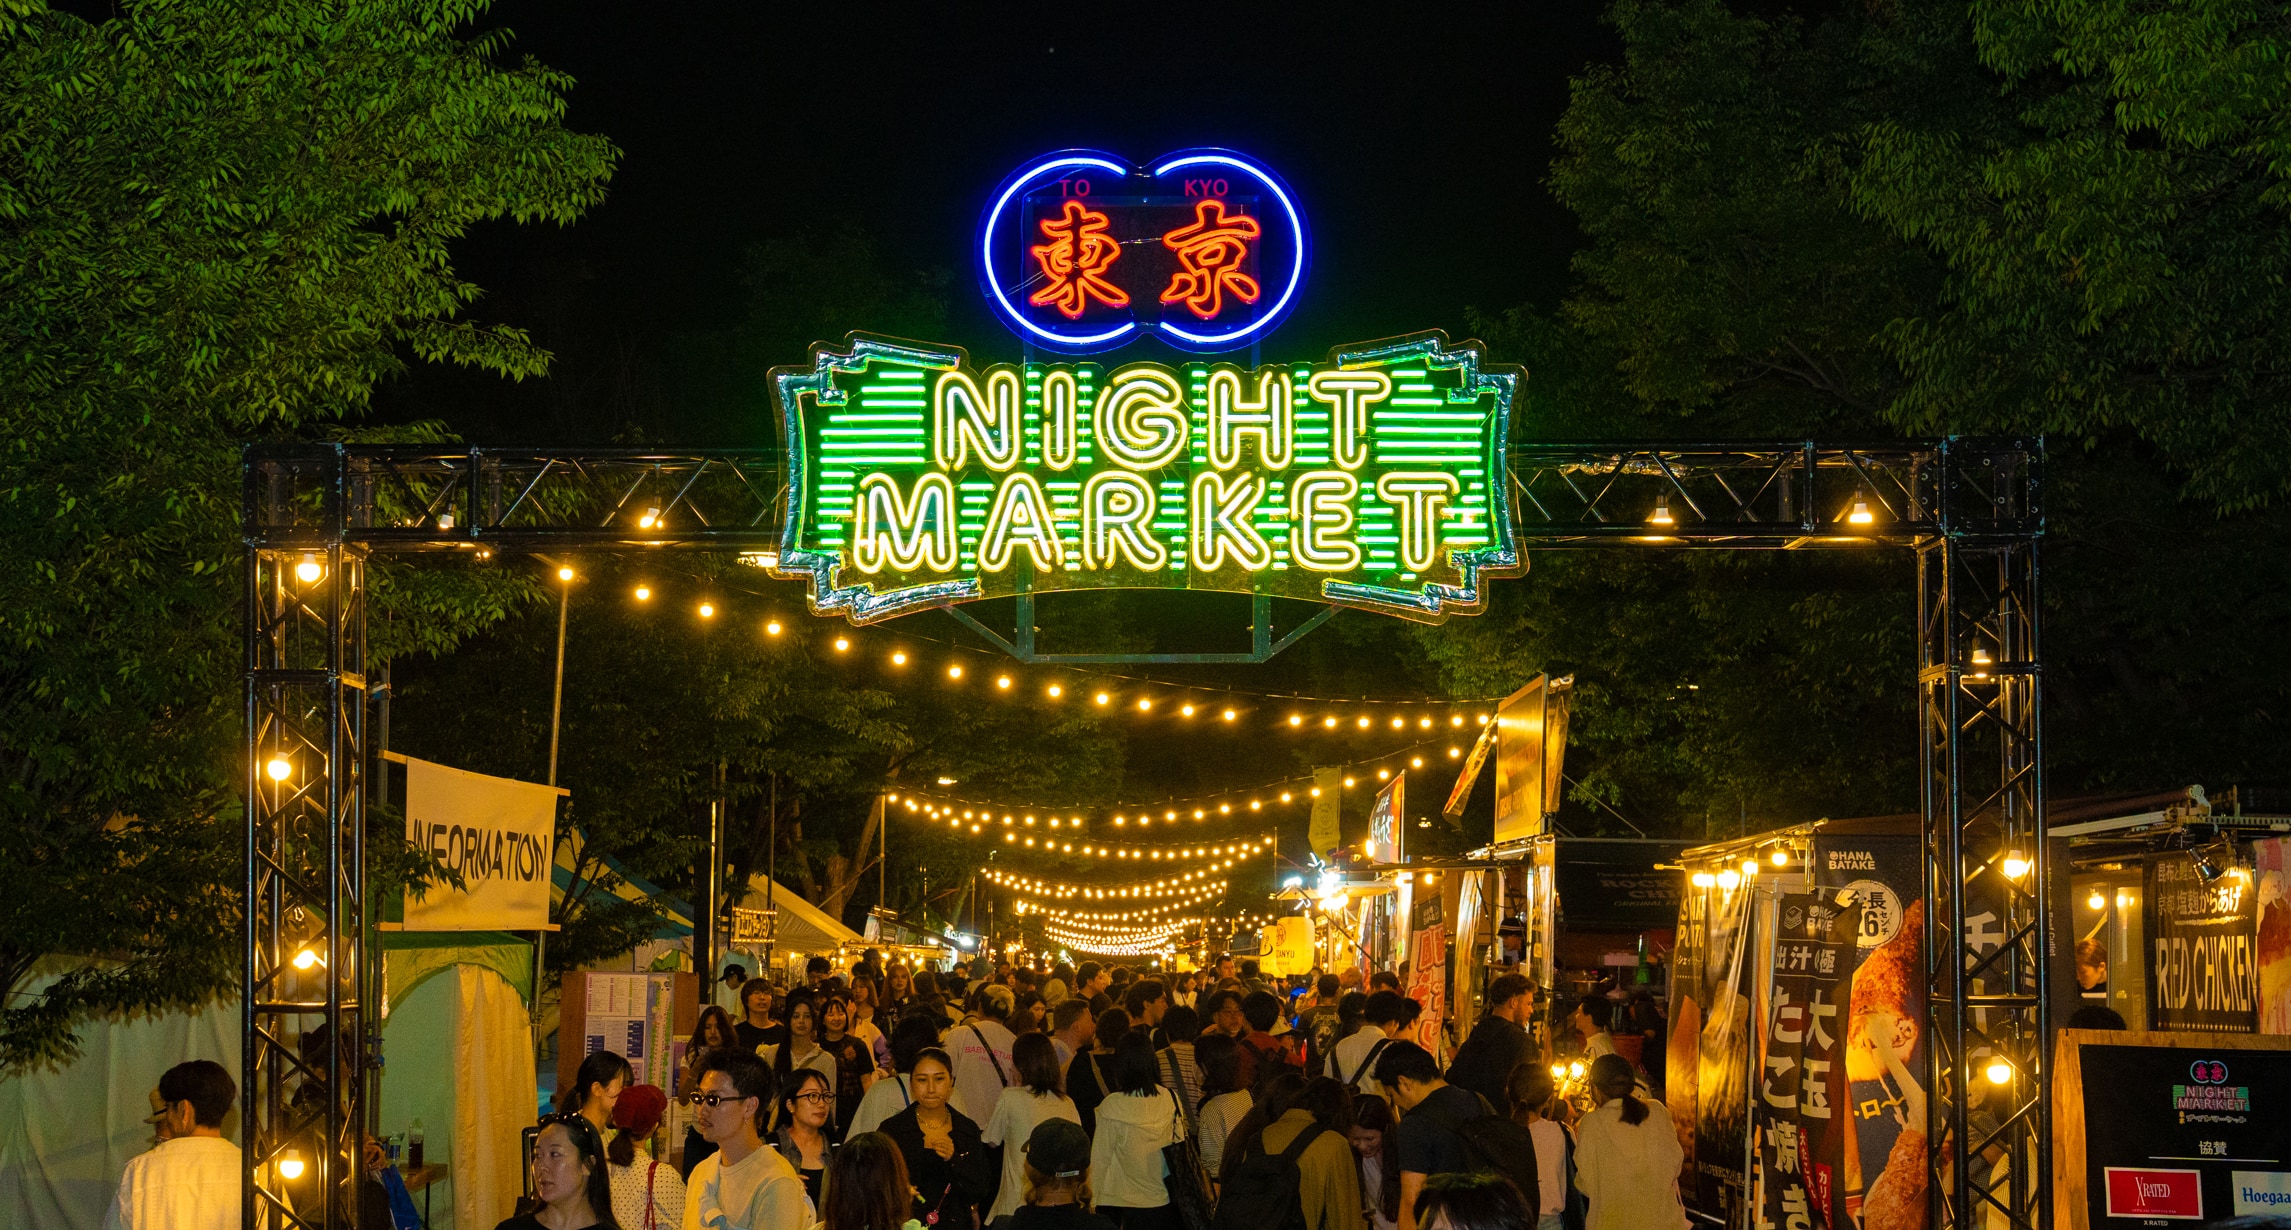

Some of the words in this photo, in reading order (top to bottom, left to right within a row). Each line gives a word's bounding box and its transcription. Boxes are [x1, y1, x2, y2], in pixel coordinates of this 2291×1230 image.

[1058, 179, 1091, 197] TO
[1184, 179, 1229, 197] KYO
[1030, 199, 1261, 320] 東京
[934, 369, 1393, 472] NIGHT
[854, 470, 1459, 574] MARKET
[413, 818, 547, 882] INFORMATION
[1828, 860, 1876, 870] BATAKE
[2193, 933, 2259, 1013] CHICKEN
[1800, 989, 1837, 1119] 大玉
[1763, 985, 1812, 1230] たこ焼き
[2177, 1098, 2246, 1110] MARKET
[2185, 1086, 2238, 1098] NIGHT
[2198, 1140, 2228, 1156] 協賛
